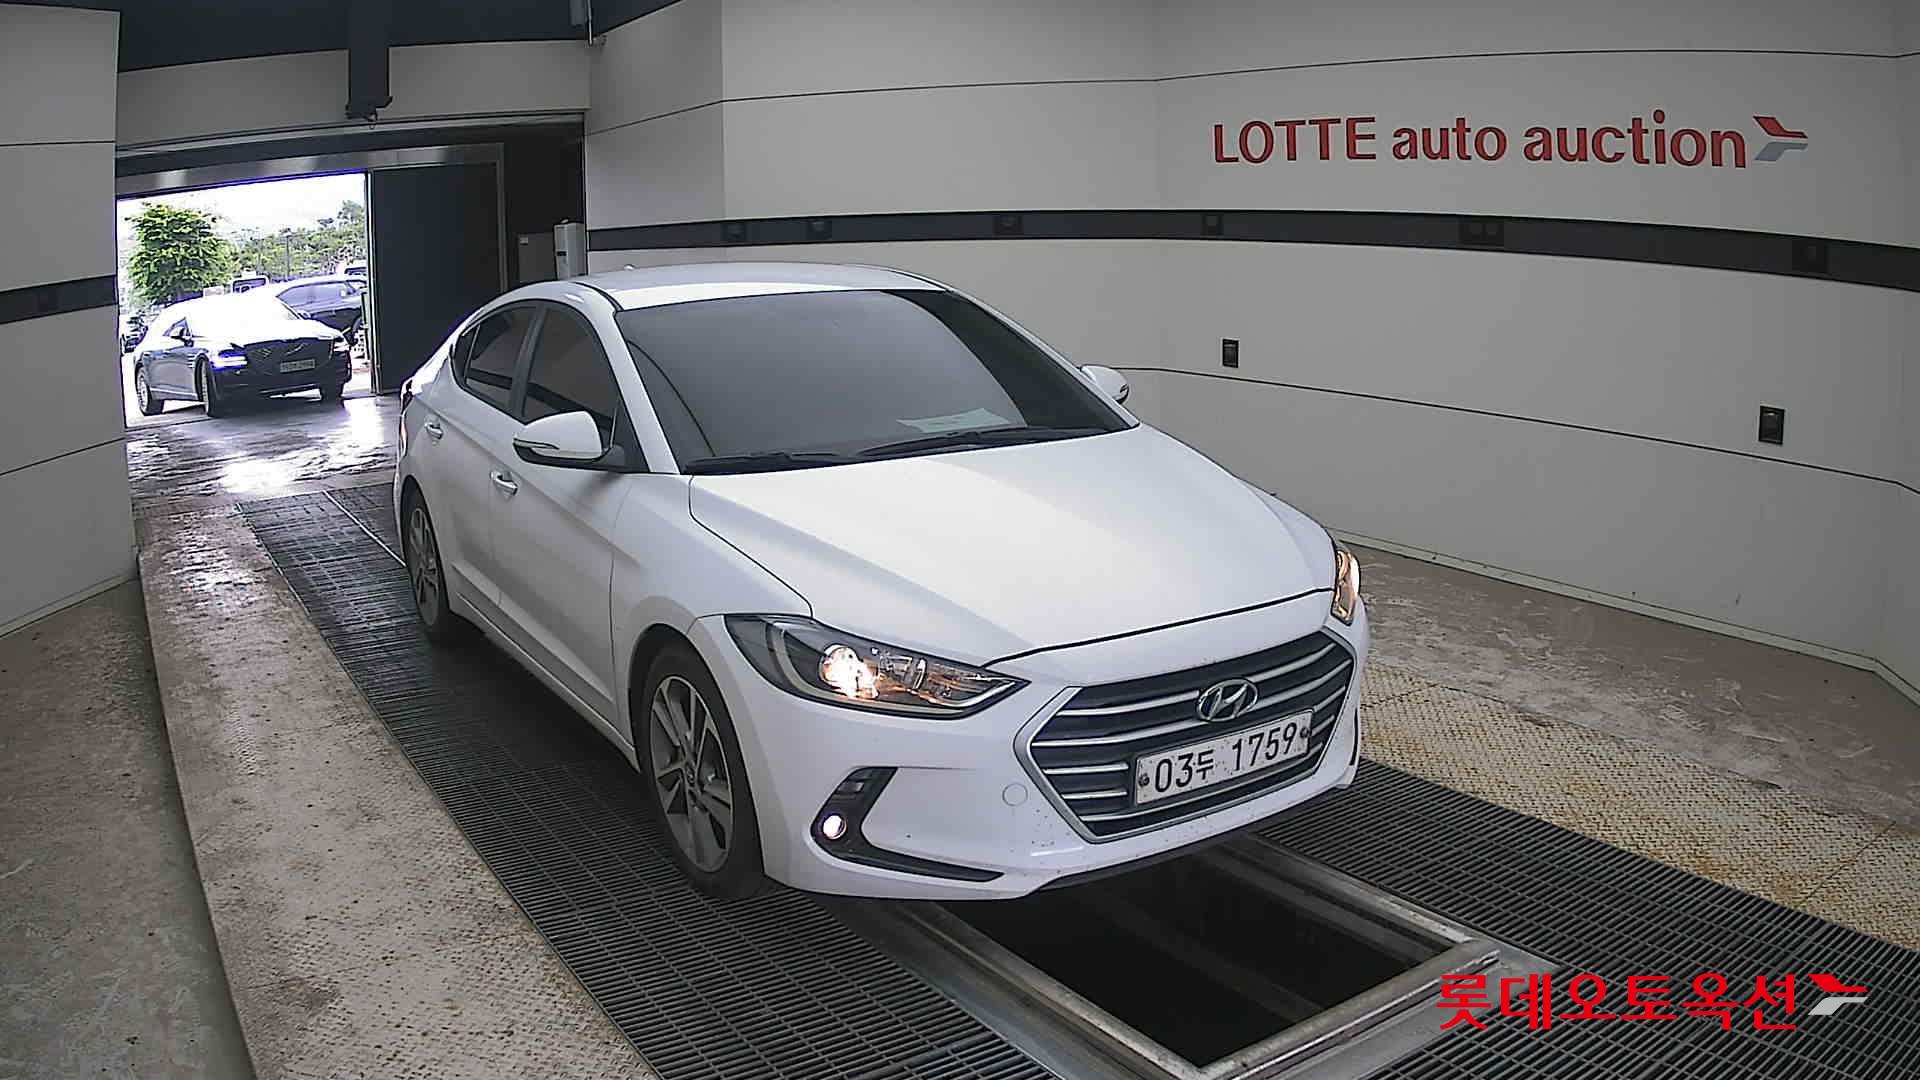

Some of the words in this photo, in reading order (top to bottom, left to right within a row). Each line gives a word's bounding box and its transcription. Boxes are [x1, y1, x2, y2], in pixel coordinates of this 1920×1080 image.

[1212, 116, 1378, 164] LOTTE
[1392, 116, 1509, 162] auto
[1523, 109, 1748, 169] auction
[1154, 749, 1216, 793] 03두
[1231, 722, 1298, 772] 1759
